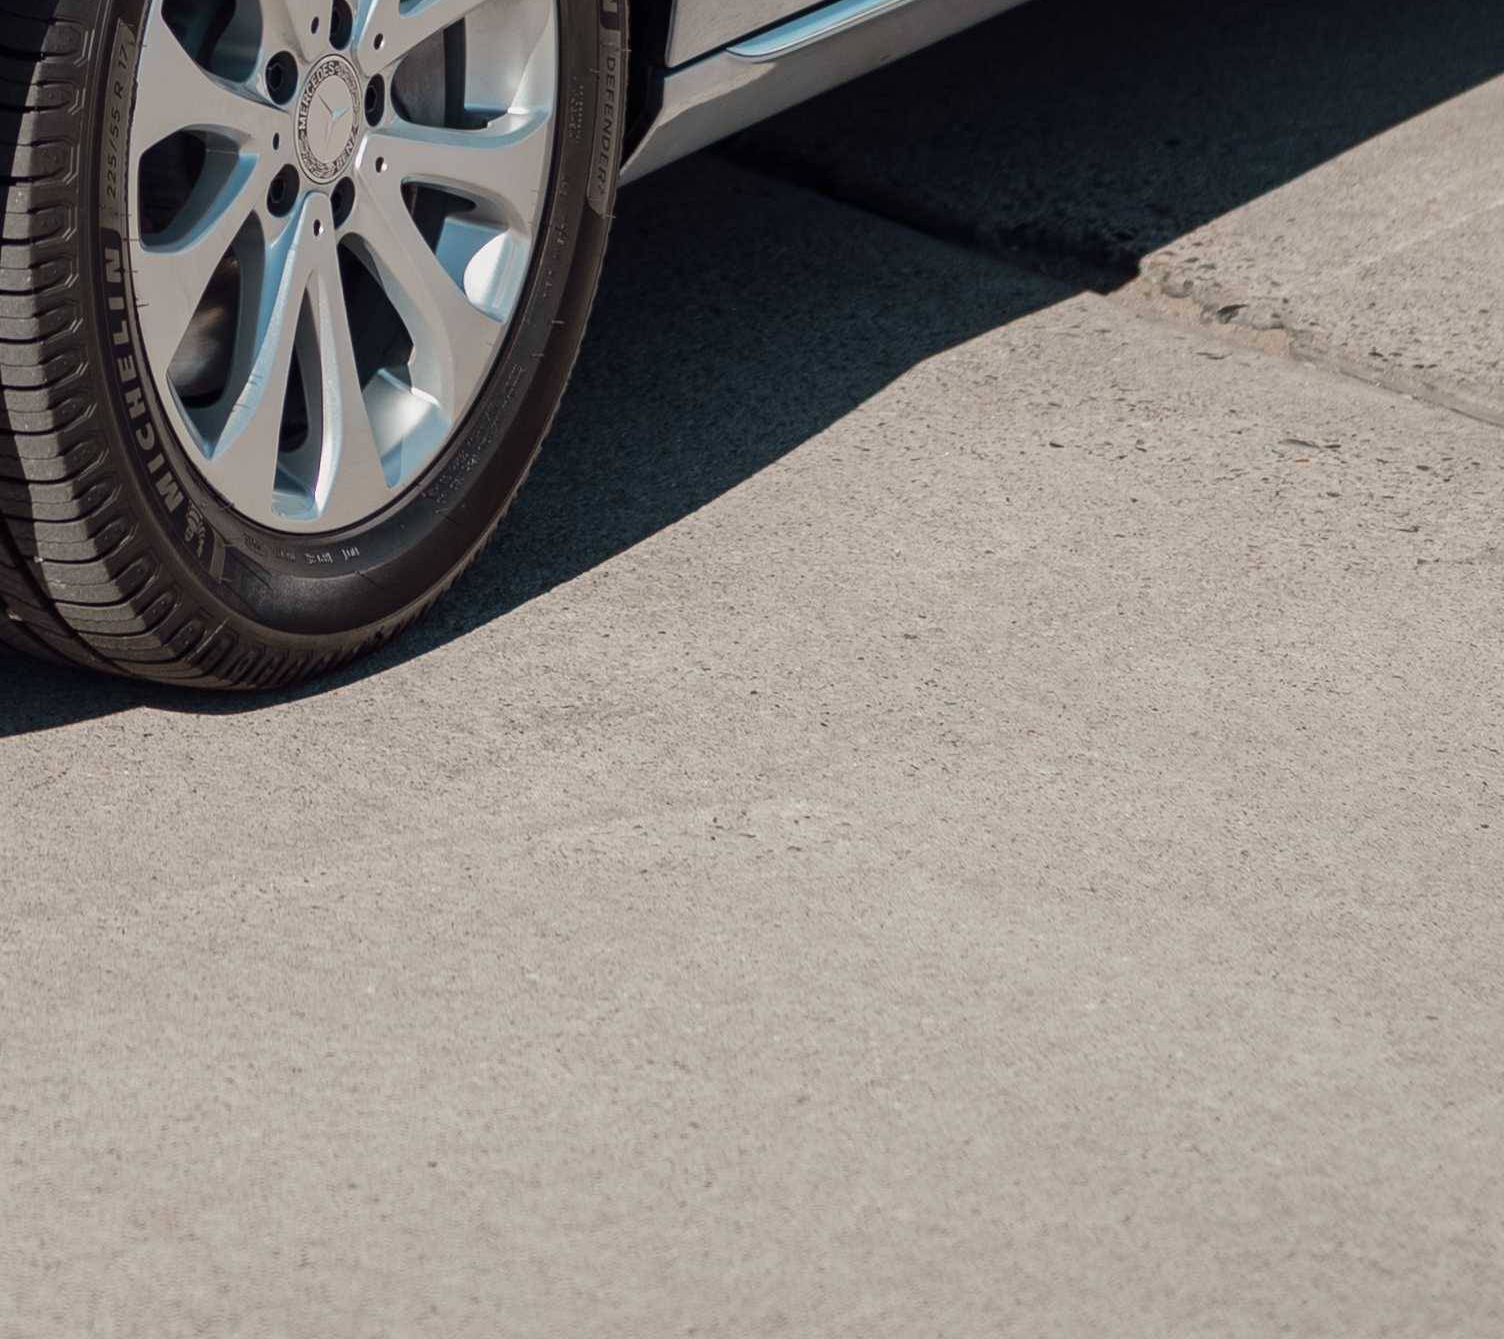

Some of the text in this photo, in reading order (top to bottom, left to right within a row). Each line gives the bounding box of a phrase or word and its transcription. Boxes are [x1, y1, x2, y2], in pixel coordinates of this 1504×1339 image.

[106, 44, 130, 199] 225/55 R 17
[298, 62, 335, 130] MERCEDES
[105, 248, 184, 513] MICHELIN
